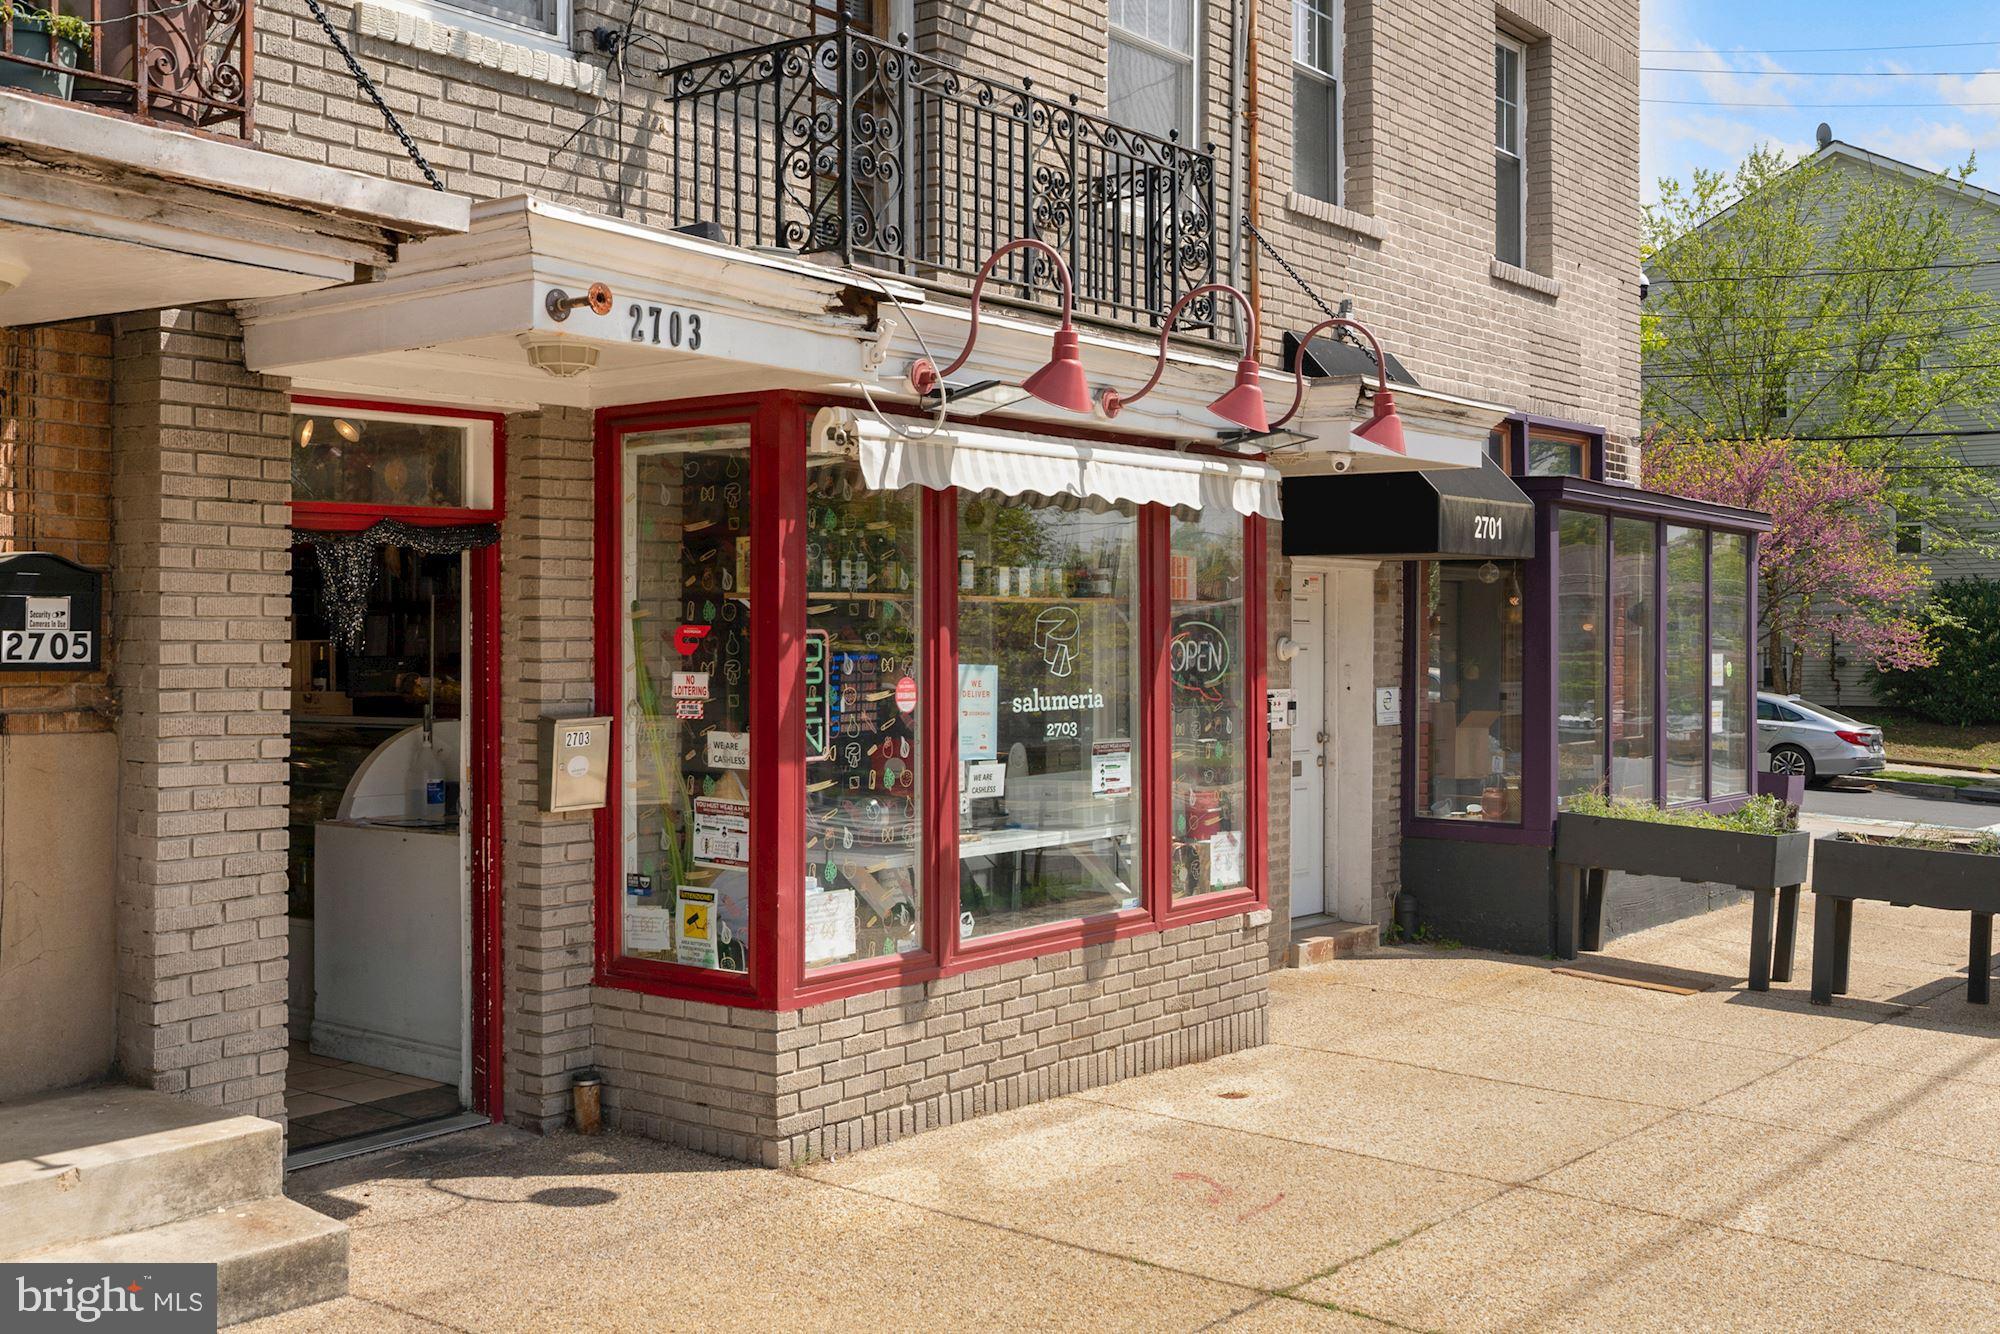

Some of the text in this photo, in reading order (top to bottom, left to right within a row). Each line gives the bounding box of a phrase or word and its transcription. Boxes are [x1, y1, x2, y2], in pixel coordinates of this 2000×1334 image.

[629, 304, 702, 350] 2703
[1474, 515, 1502, 540] 2701
[29, 610, 51, 619] Security
[29, 620, 51, 628] Cameras
[57, 620, 66, 628] Use
[6, 632, 89, 660] 2705
[1170, 640, 1222, 672] OPEN
[685, 675, 695, 685] NO
[971, 680, 982, 688] WE
[674, 685, 708, 697] LOITERING
[962, 690, 991, 698] DELIVER
[1012, 688, 1105, 713] salumeria
[1046, 721, 1078, 738] 2703
[566, 731, 590, 747] 2703
[713, 741, 739, 751] WE ARE
[713, 754, 746, 765] CASHLESS
[973, 773, 993, 782] WE ARE
[971, 785, 997, 794] CASHLESS
